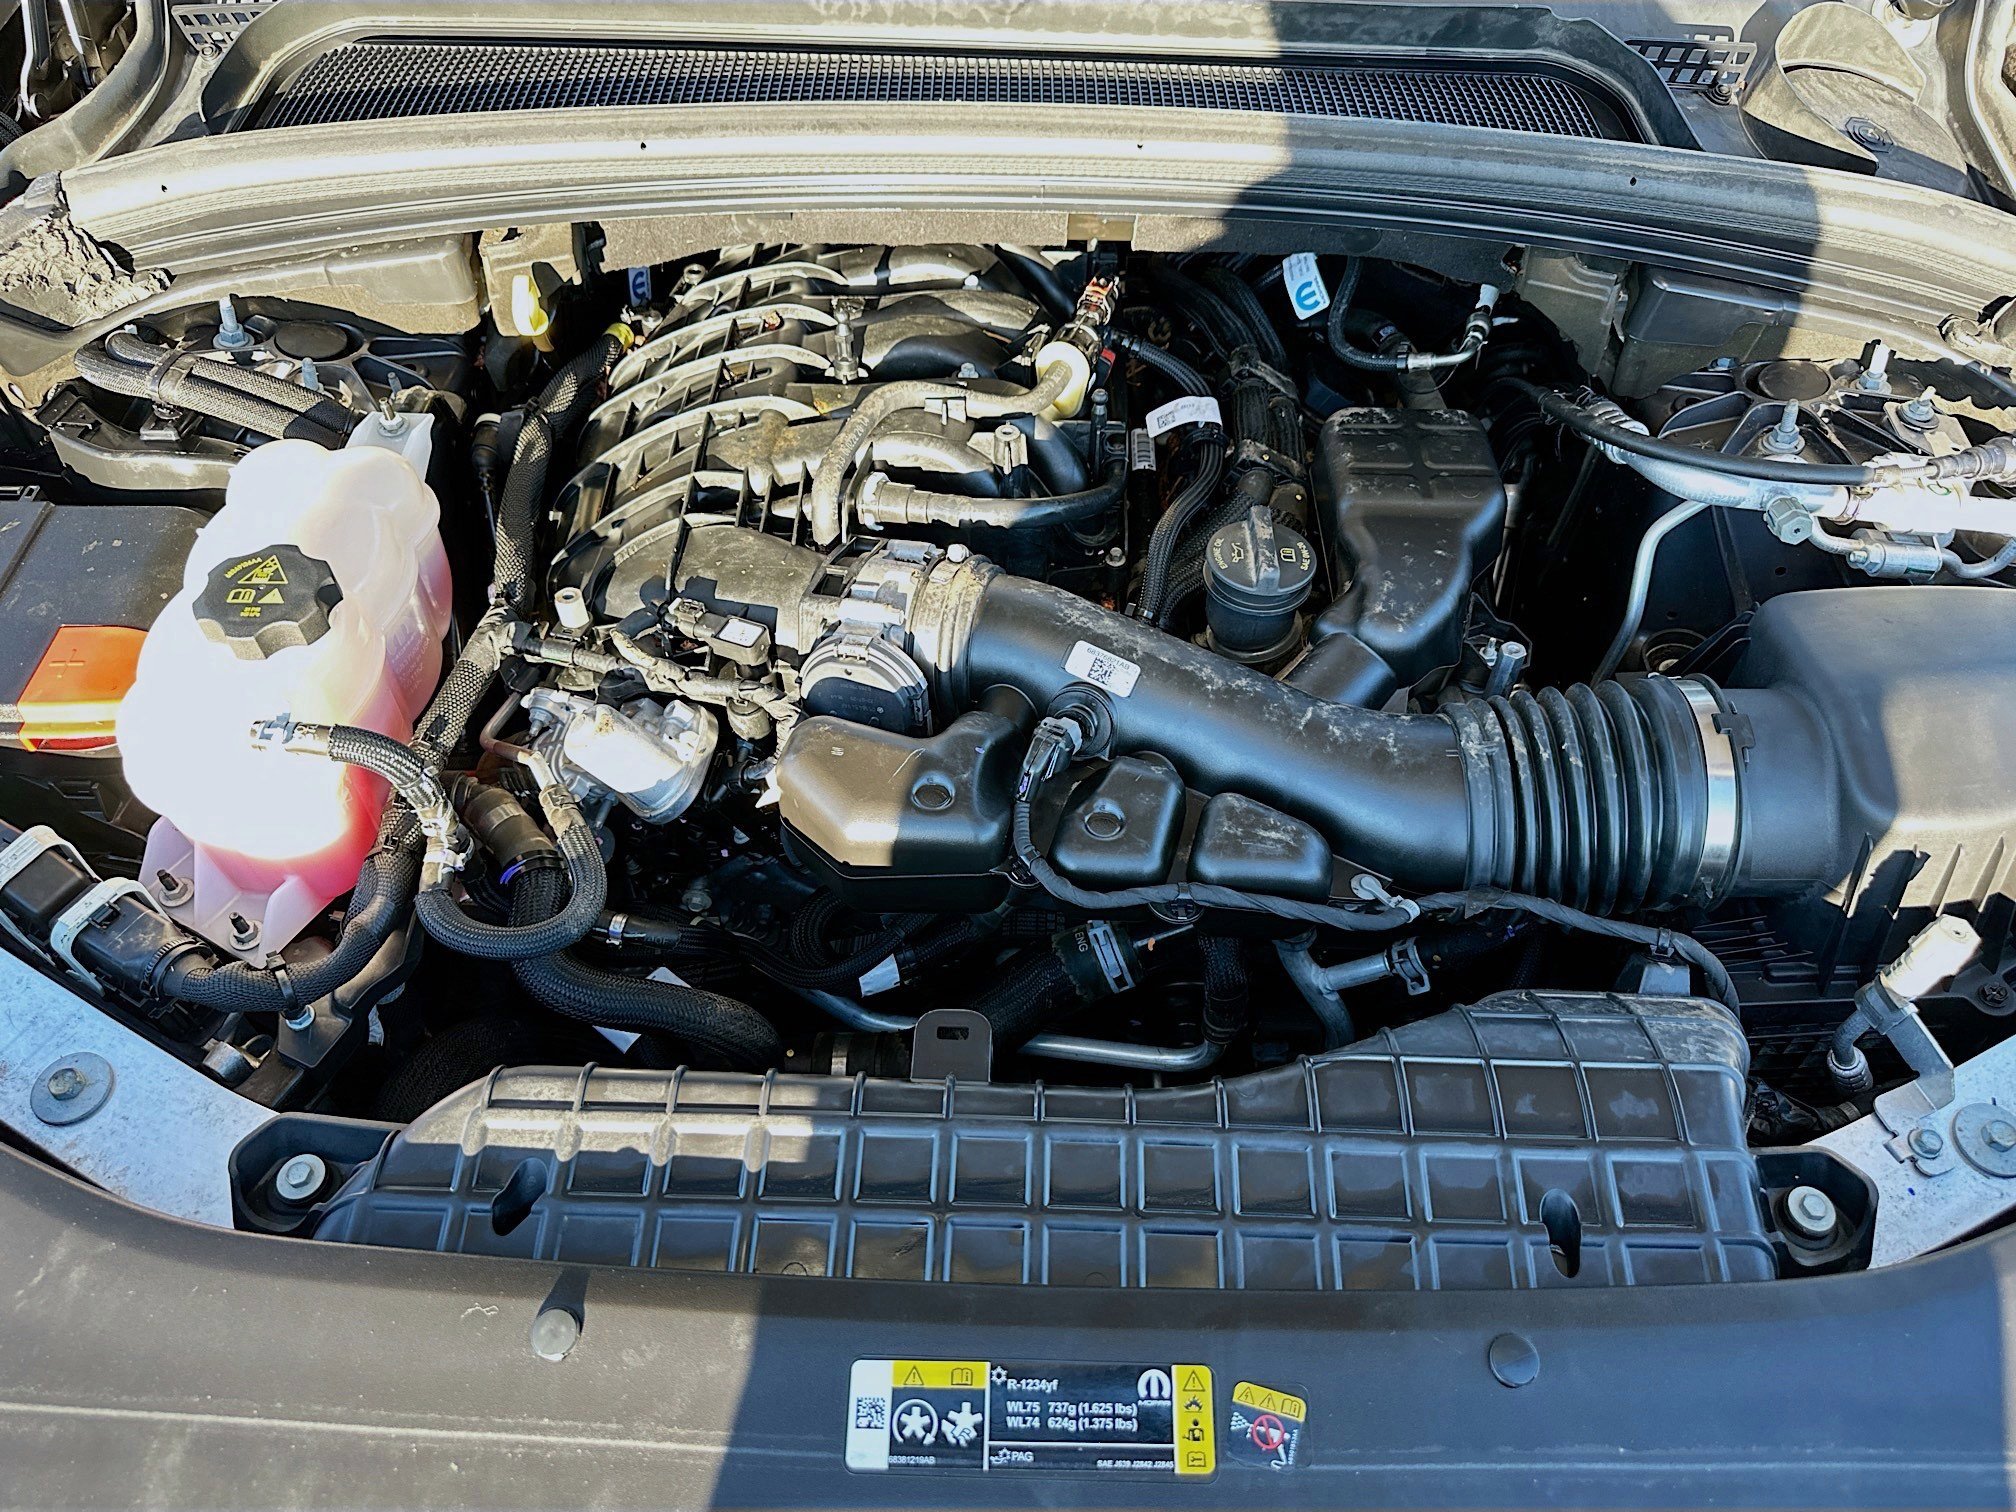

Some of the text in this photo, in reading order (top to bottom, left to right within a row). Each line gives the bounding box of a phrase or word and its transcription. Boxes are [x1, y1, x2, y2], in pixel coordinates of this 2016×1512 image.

[1213, 546, 1229, 570] ENGINE
[1300, 559, 1311, 571] SAE
[1074, 931, 1089, 953] ENG
[1007, 1378, 1060, 1393] R-1234yf
[1006, 1401, 1138, 1417] WL75 737g (1.625 lbs)
[1006, 1416, 1138, 1432] WL74 624g (1.375 lbs)
[1011, 1451, 1035, 1462] PAG
[1096, 1459, 1113, 1468] SAE
